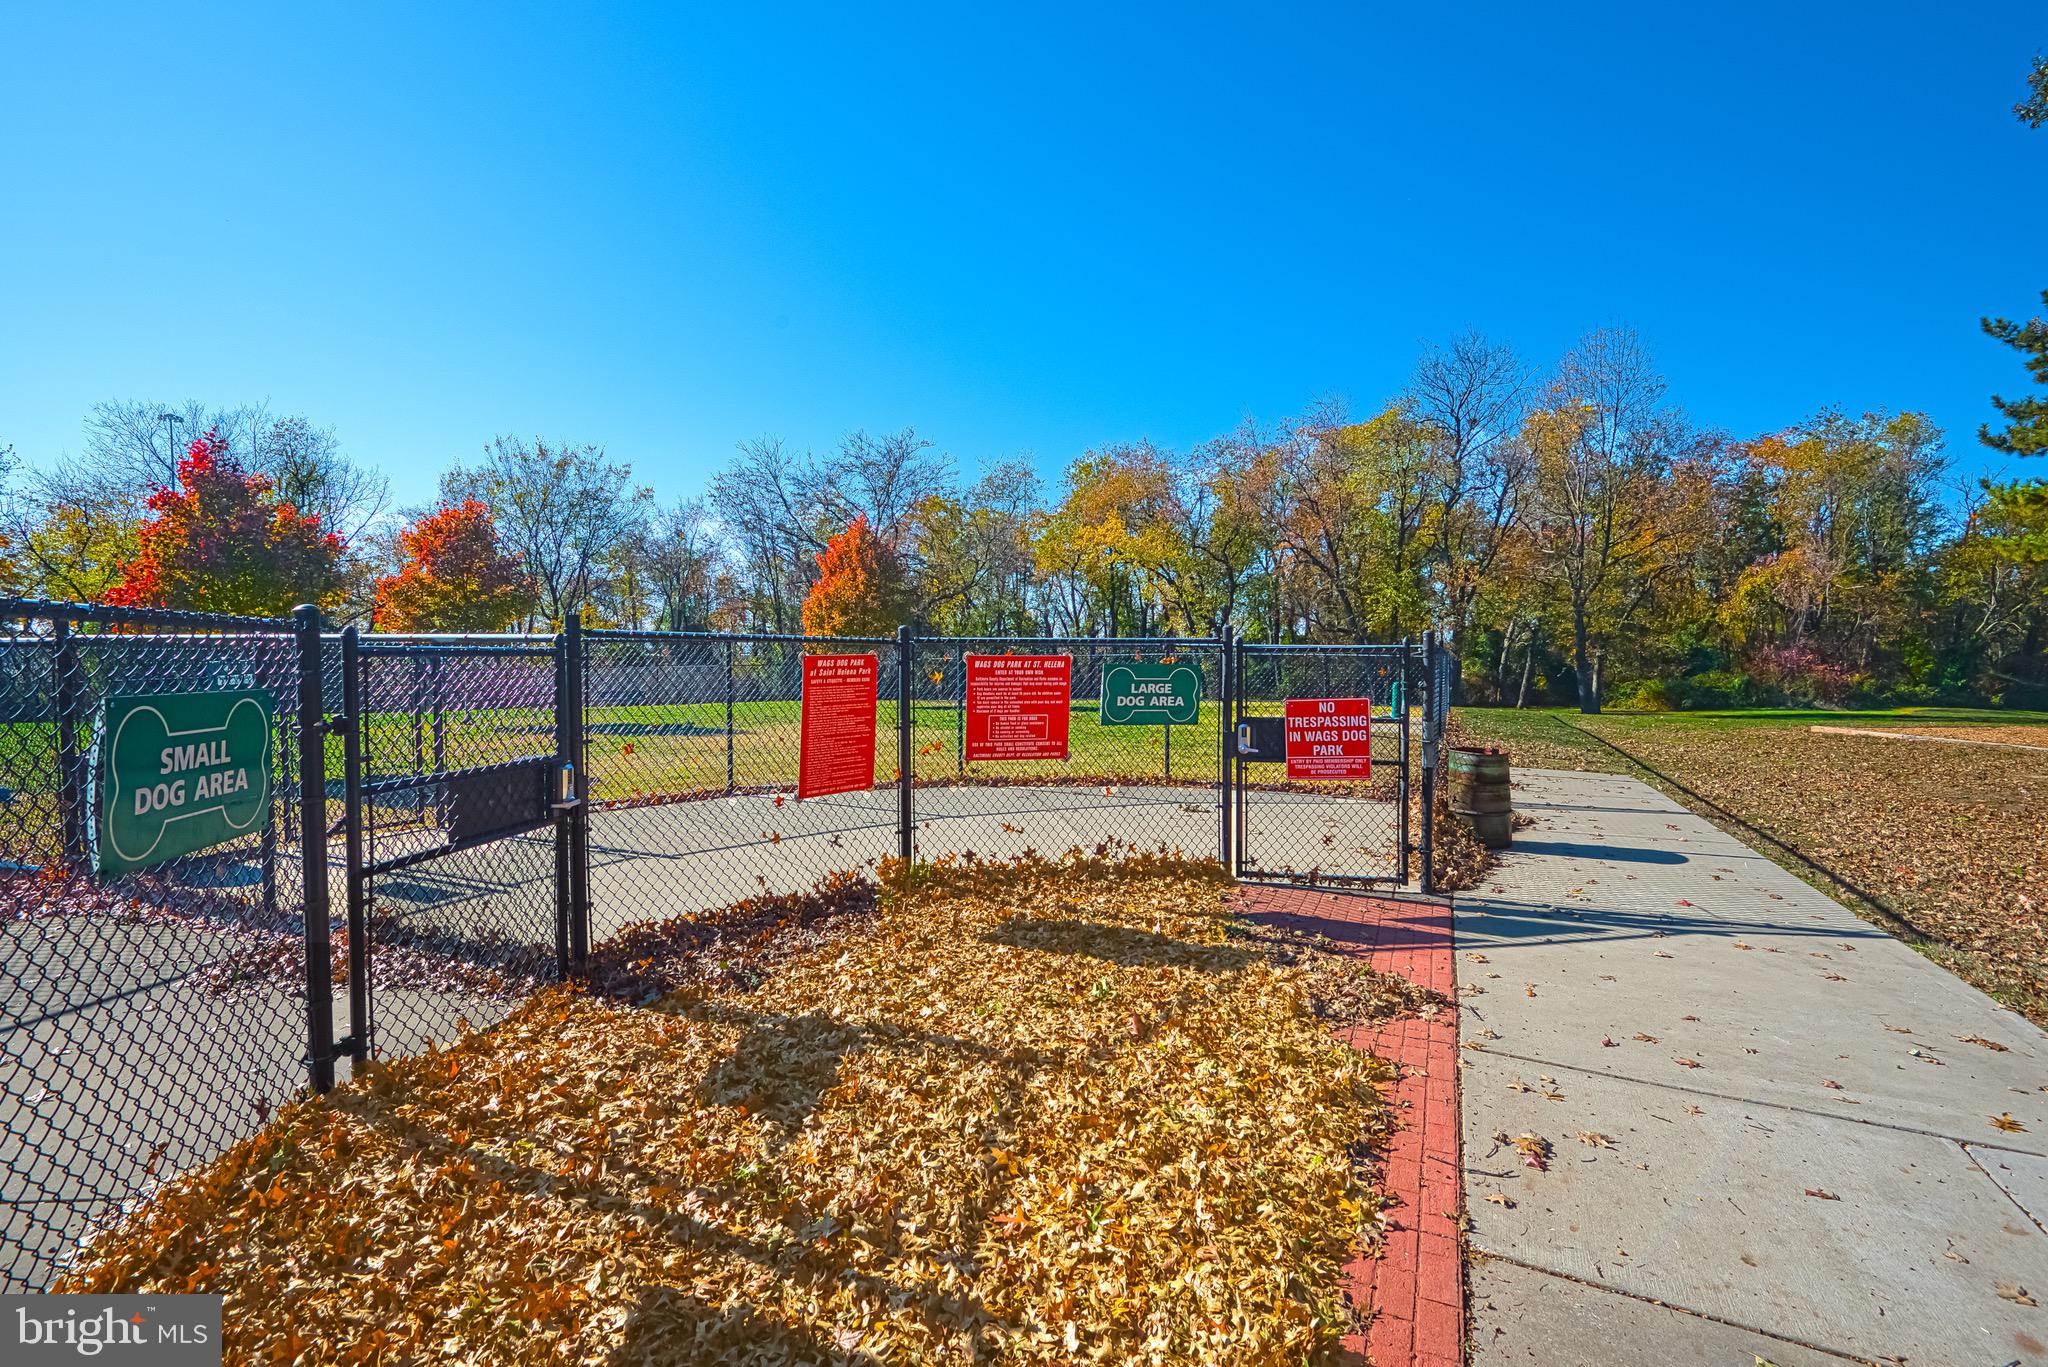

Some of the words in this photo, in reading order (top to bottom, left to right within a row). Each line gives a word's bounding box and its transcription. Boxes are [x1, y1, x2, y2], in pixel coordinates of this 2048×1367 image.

[1131, 683, 1172, 694] LARGE
[1116, 696, 1145, 707] DOG
[1150, 696, 1184, 706] AREA
[1319, 702, 1335, 713] NO
[1288, 715, 1367, 728] TRESPASSING
[1289, 731, 1300, 742] IN
[1304, 731, 1338, 741] WAGS
[1342, 730, 1367, 741] DOG
[1313, 745, 1343, 756] PARK
[160, 740, 231, 775] SMALL
[135, 780, 185, 816] DOG
[193, 768, 248, 801] AREA
